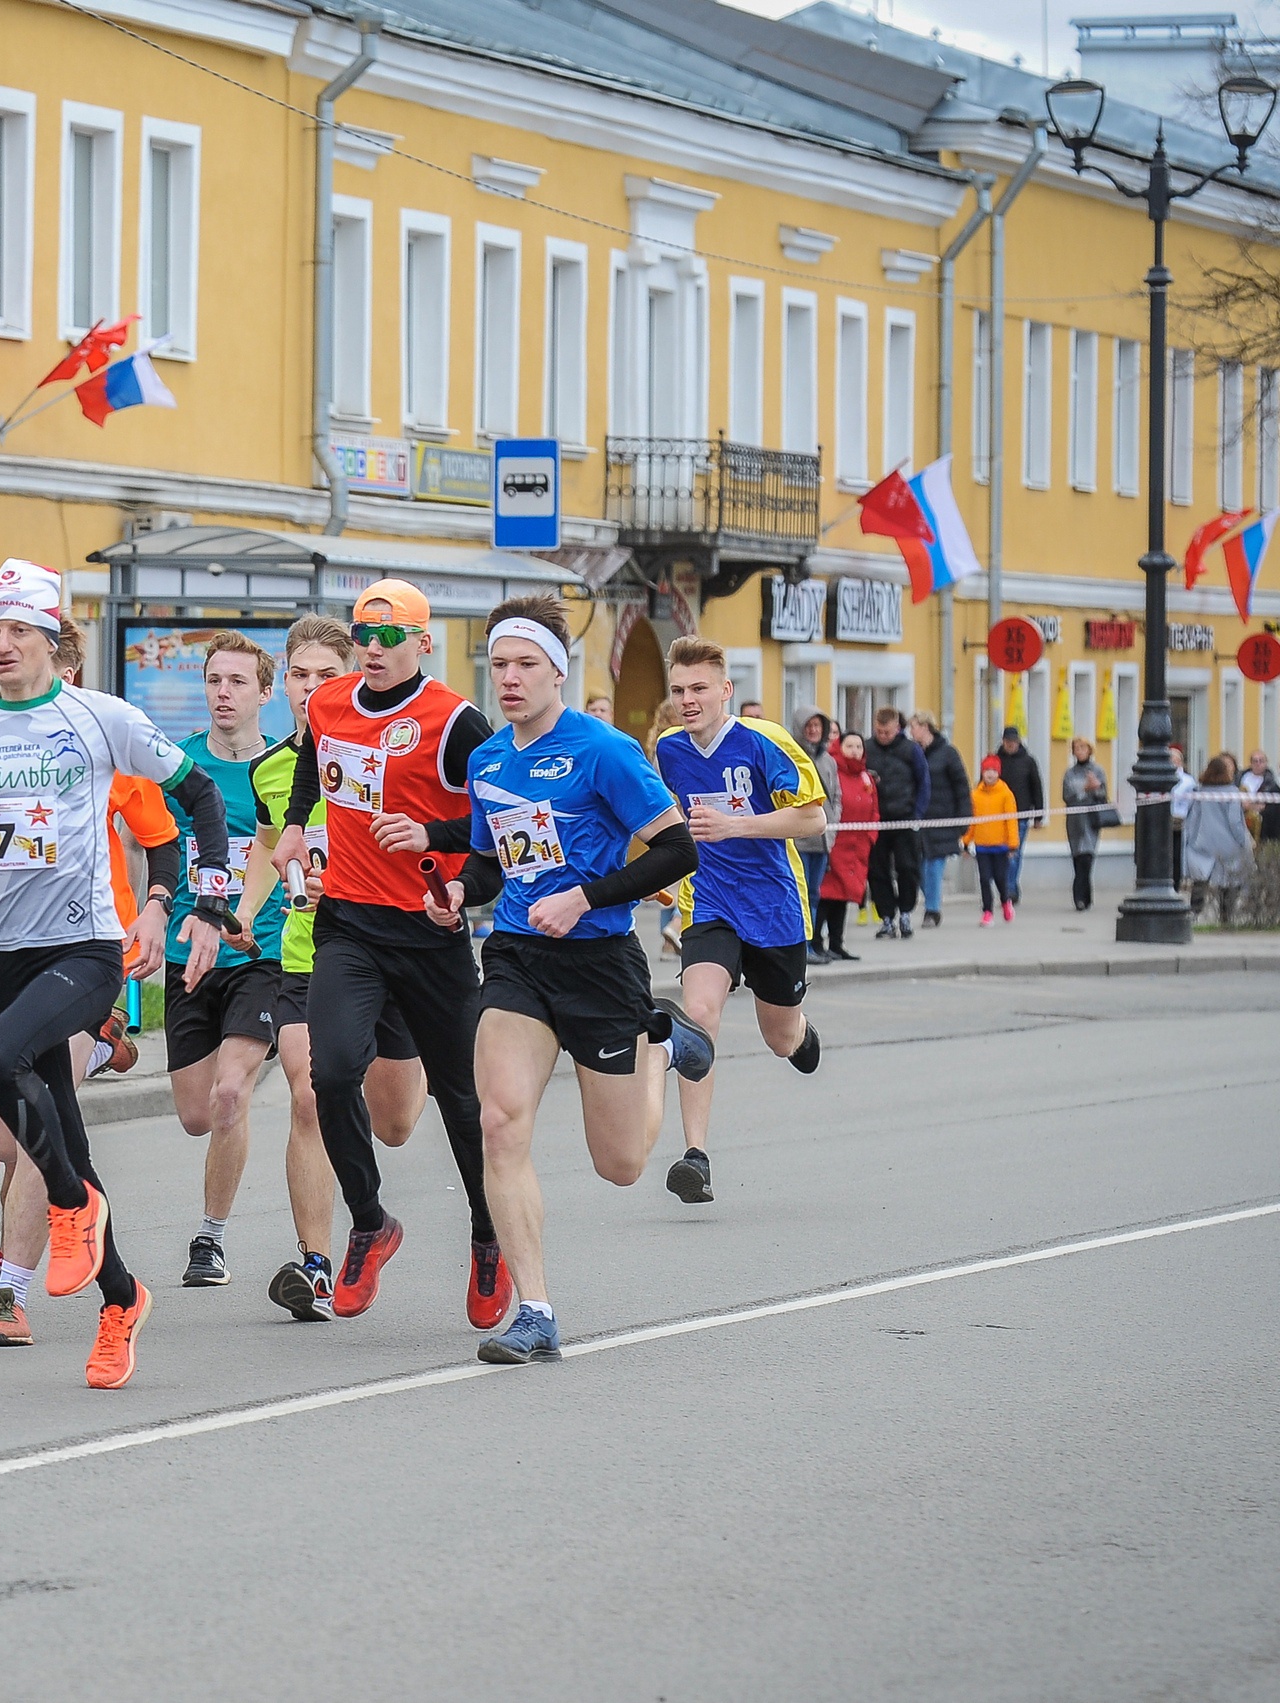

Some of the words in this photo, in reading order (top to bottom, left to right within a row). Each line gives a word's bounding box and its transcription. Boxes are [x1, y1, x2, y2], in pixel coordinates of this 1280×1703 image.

[23, 744, 40, 752] БЕГА
[326, 761, 343, 793] 9
[722, 766, 753, 797] 18
[362, 783, 371, 801] 1
[33, 836, 43, 856] 1
[498, 830, 536, 868] 12
[541, 839, 553, 858] 1
